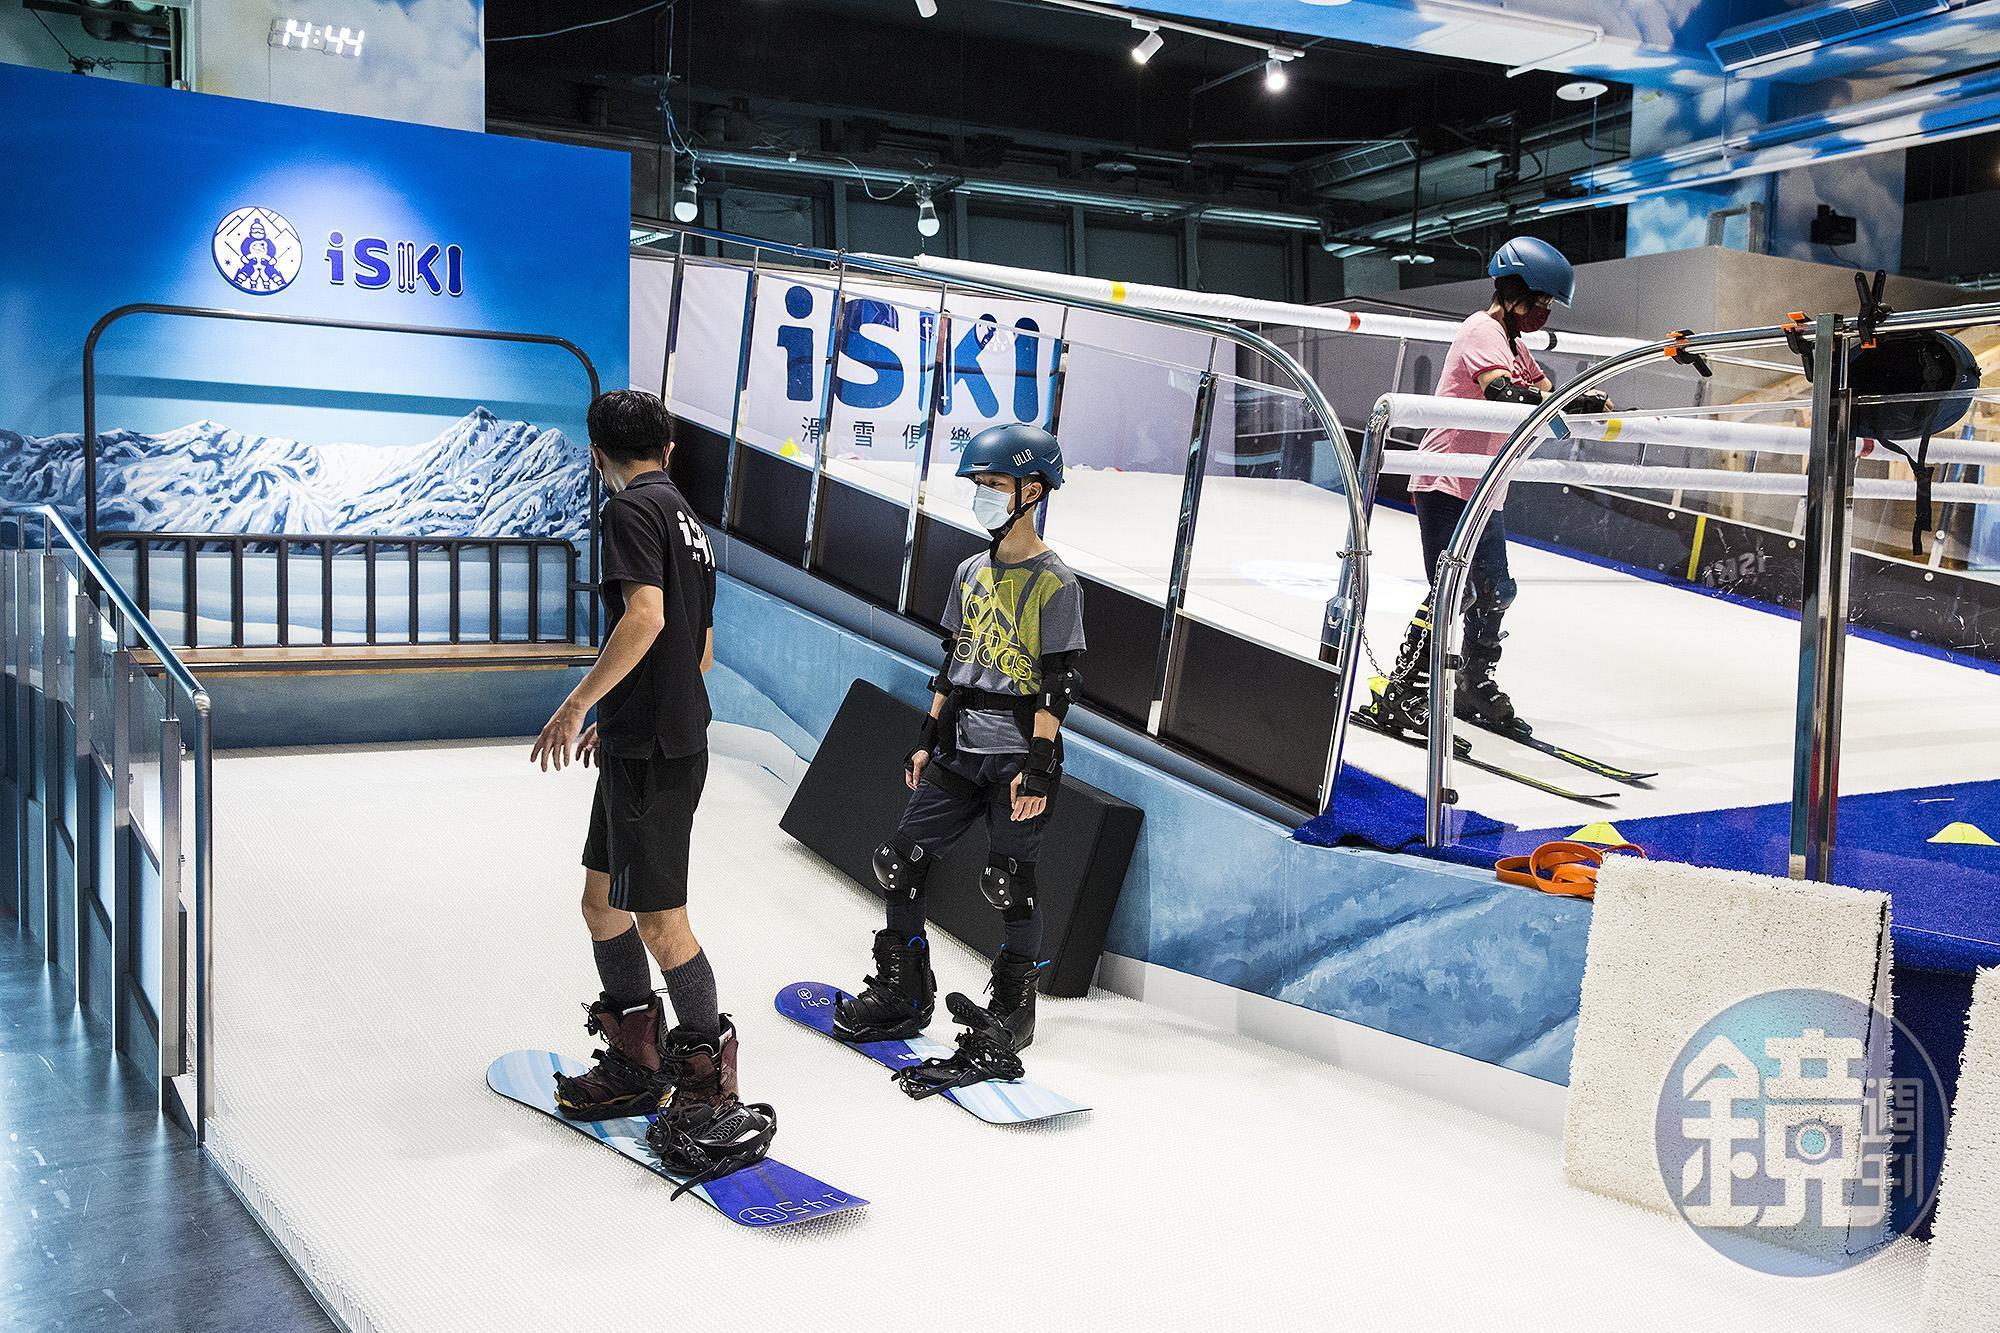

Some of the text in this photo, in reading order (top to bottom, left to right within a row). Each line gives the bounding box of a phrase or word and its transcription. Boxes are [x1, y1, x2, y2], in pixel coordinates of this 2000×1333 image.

[282, 19, 365, 57] 14:44
[325, 230, 463, 296] iSKI
[777, 285, 1040, 423] iSKI
[1012, 448, 1034, 467] ULLR
